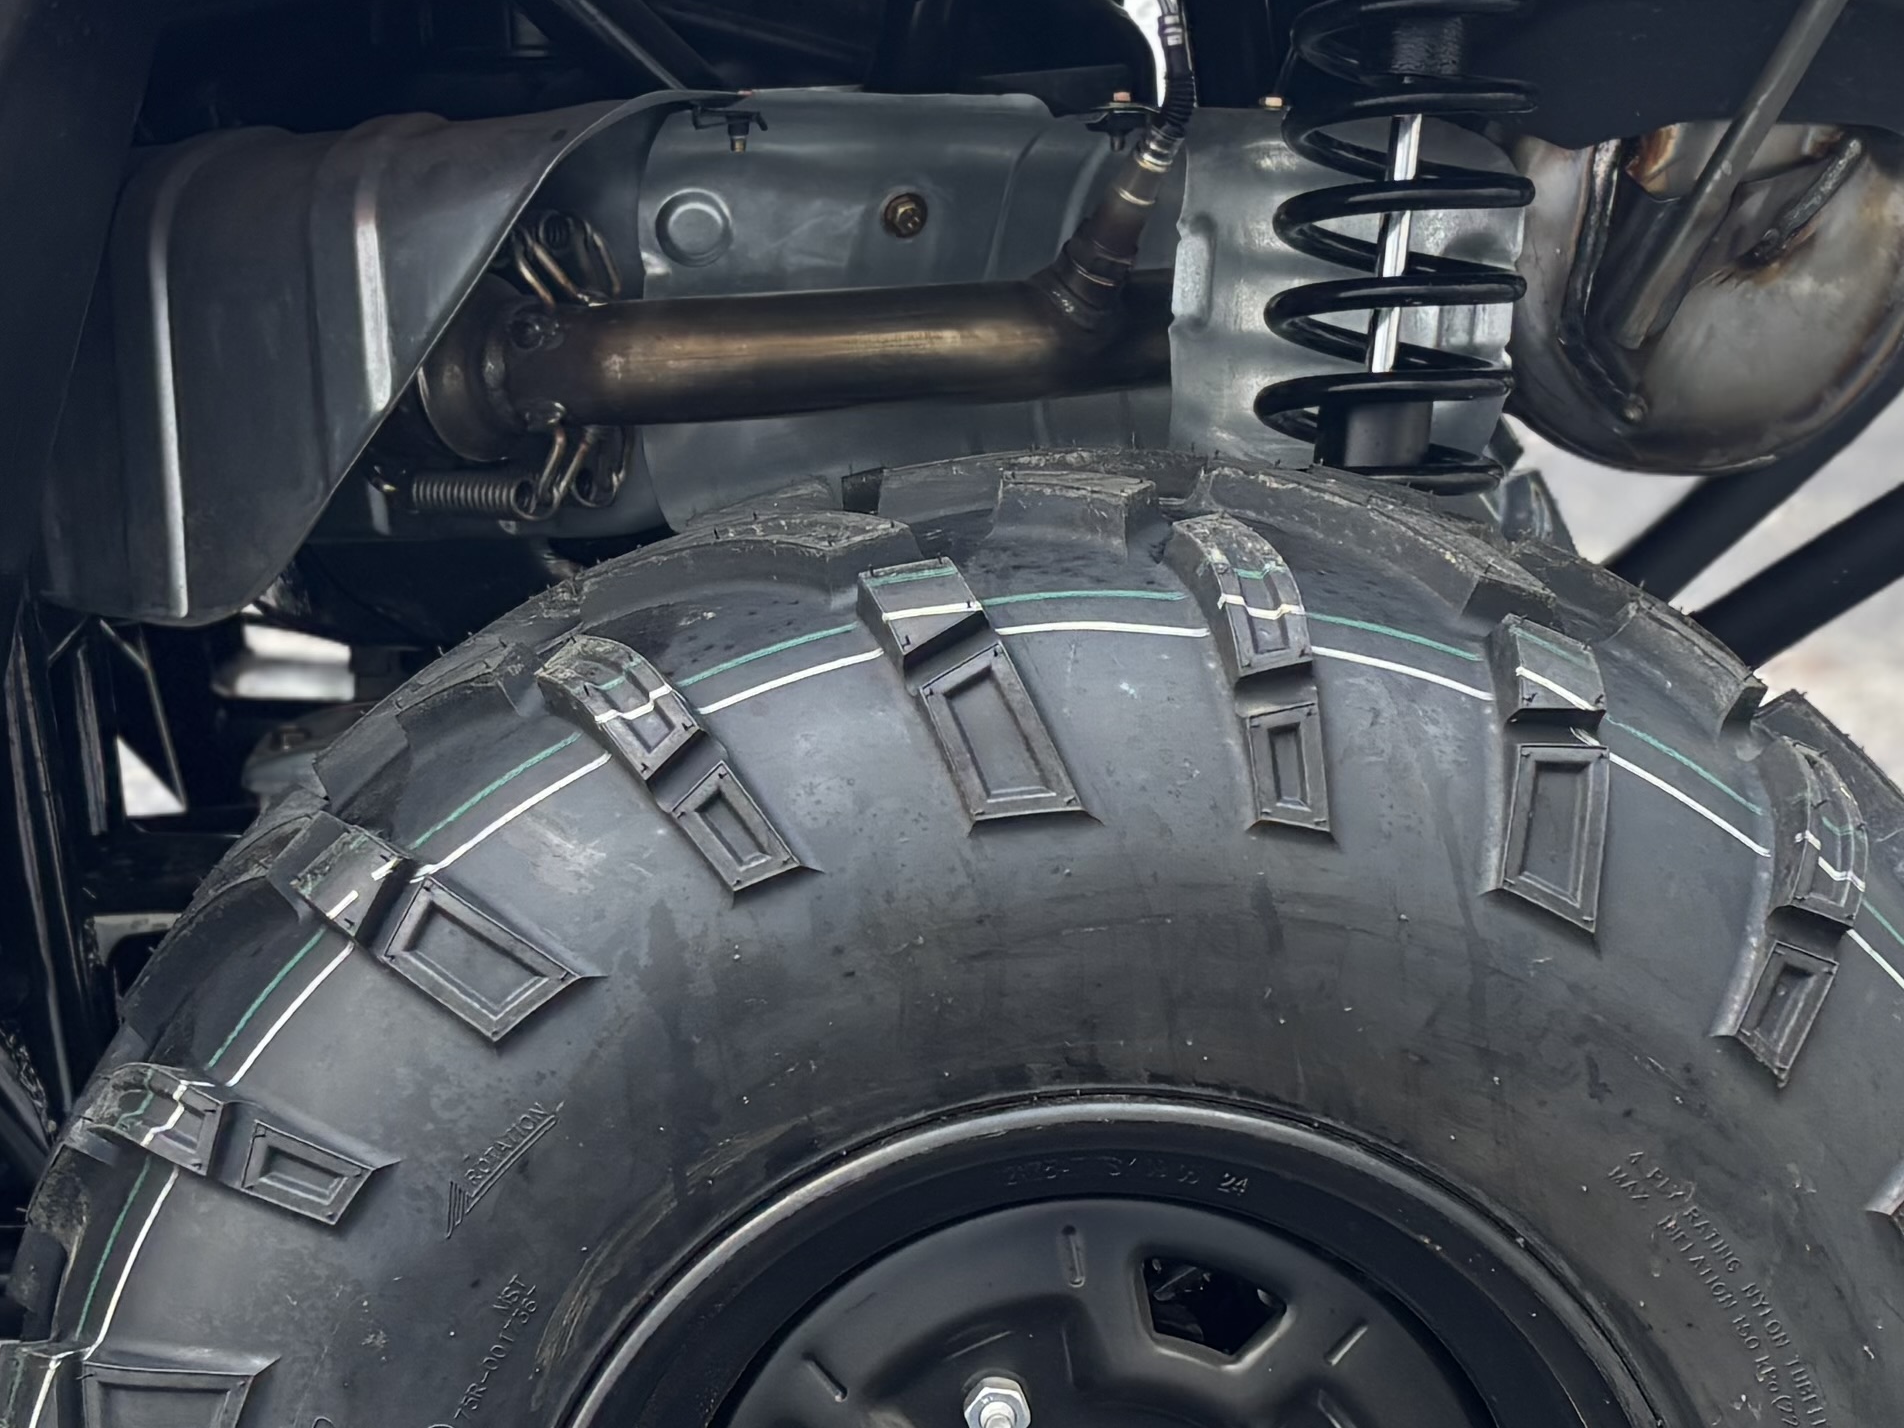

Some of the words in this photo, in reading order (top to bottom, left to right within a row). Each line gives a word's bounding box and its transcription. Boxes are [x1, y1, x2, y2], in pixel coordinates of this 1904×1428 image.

[465, 1102, 547, 1185] ROTATION
[1683, 1205, 1742, 1273] RATING
[1741, 1282, 1791, 1348] NYLON
